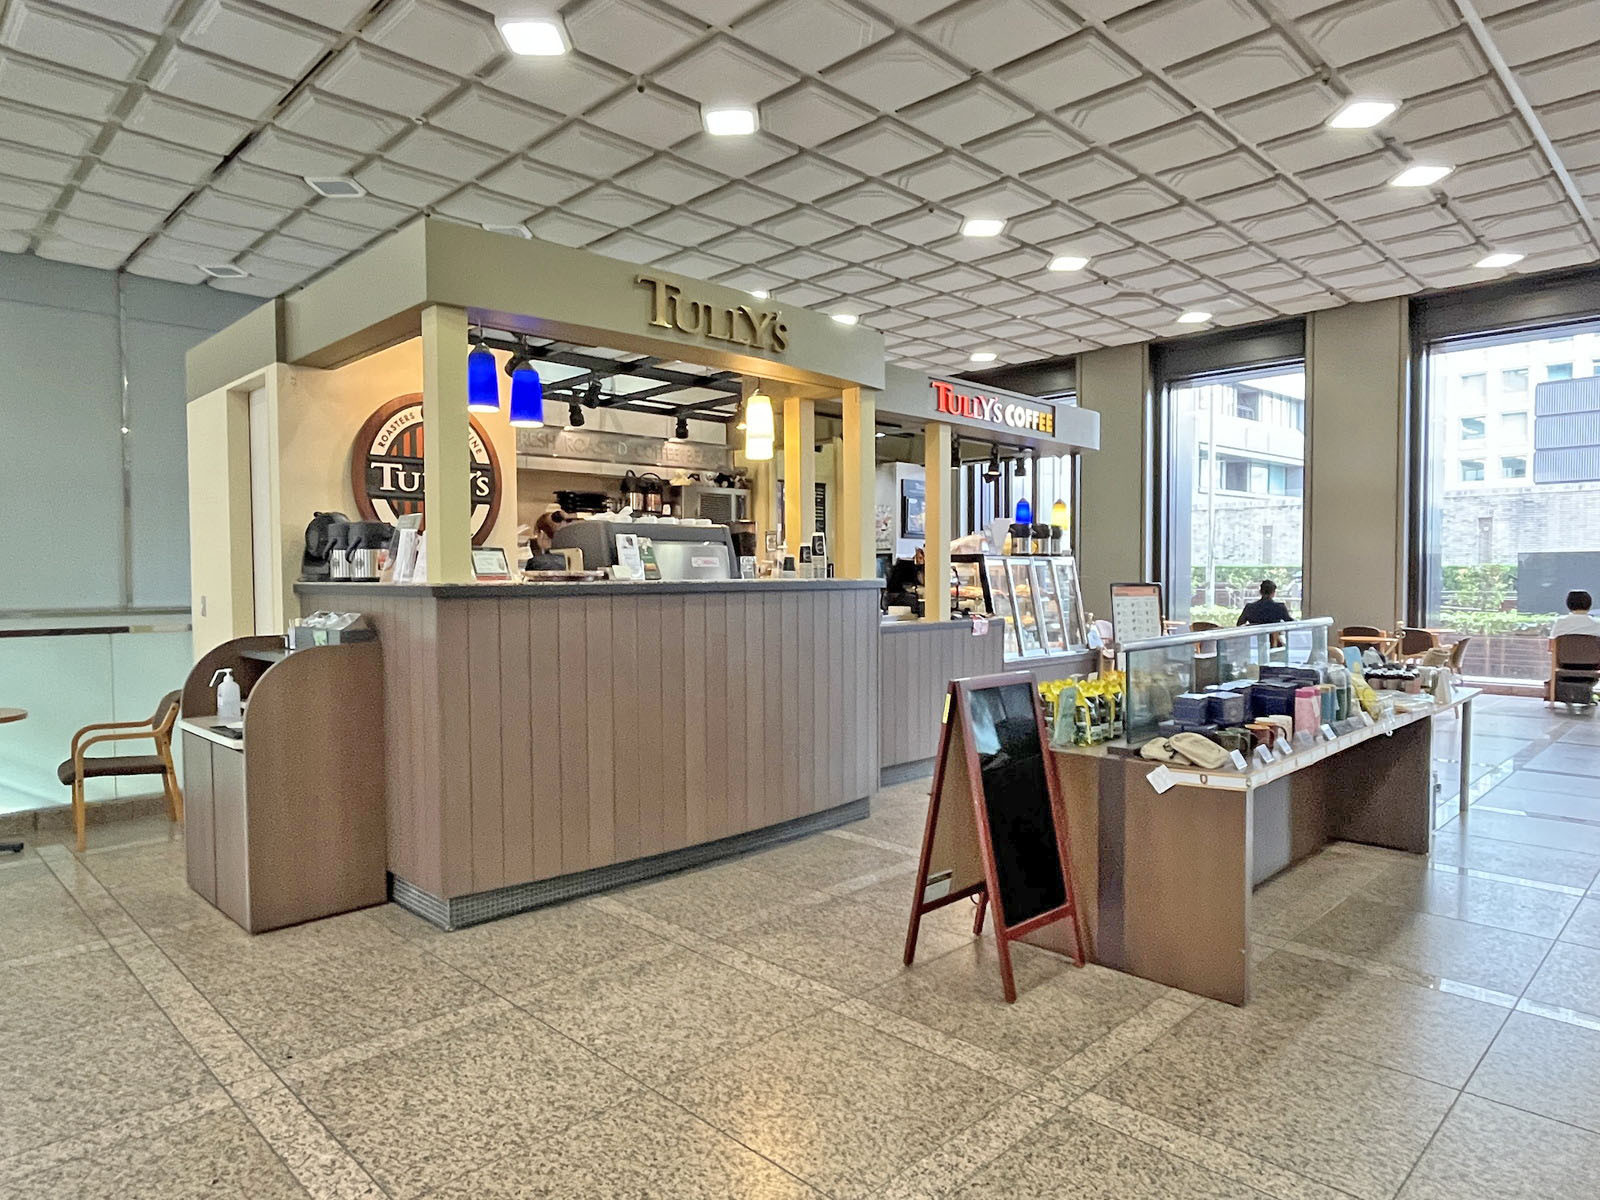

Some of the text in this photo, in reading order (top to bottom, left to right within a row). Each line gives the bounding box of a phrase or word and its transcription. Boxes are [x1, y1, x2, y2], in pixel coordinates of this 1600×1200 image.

[634, 274, 788, 353] TULLY'S
[378, 412, 415, 448] ROASTERS
[931, 381, 1053, 433] TULLY'S COFFEE
